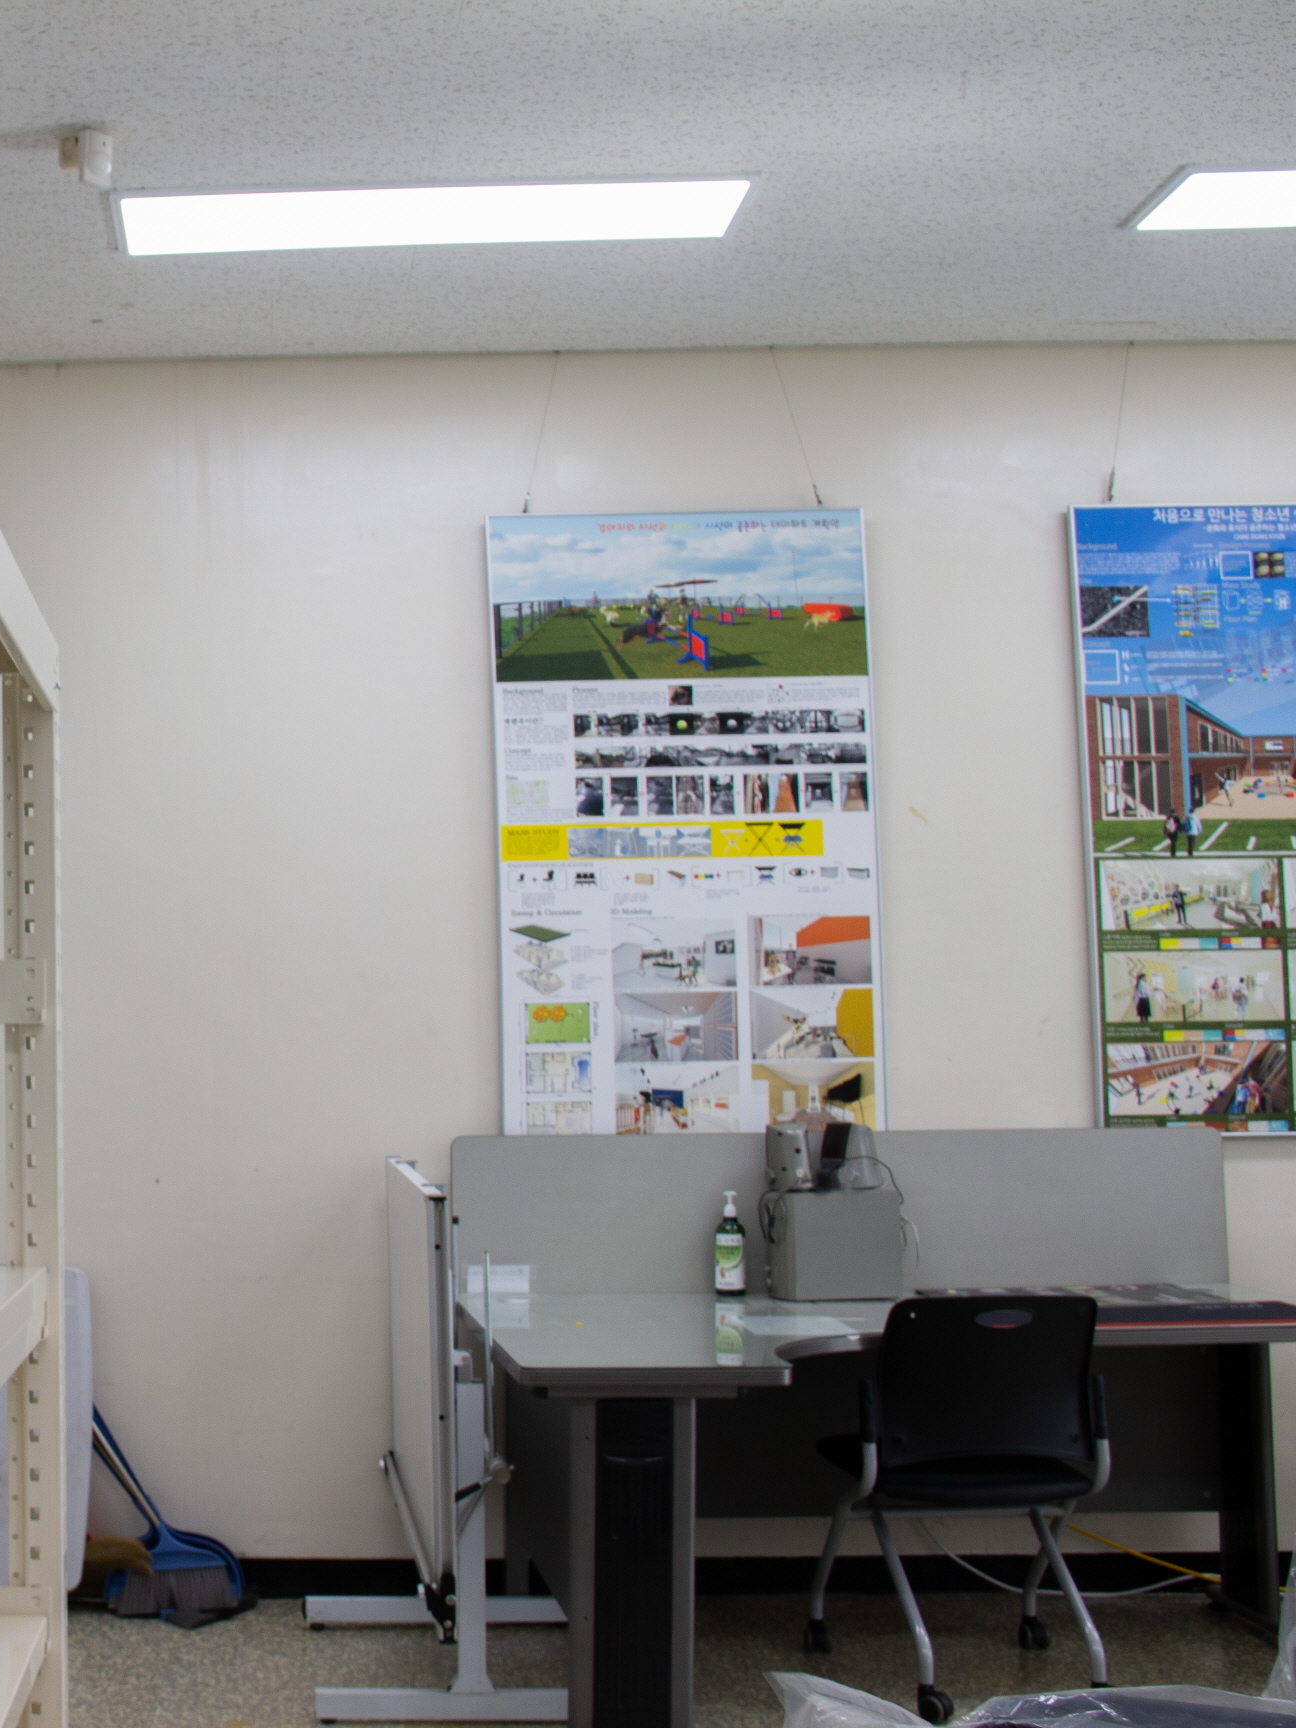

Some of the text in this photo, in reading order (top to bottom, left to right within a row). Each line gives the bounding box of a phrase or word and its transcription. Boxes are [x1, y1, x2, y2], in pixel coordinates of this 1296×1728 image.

[1153, 507, 1205, 524] 처음으로
[1207, 507, 1248, 523] 만나는
[1251, 507, 1290, 523] 청소년
